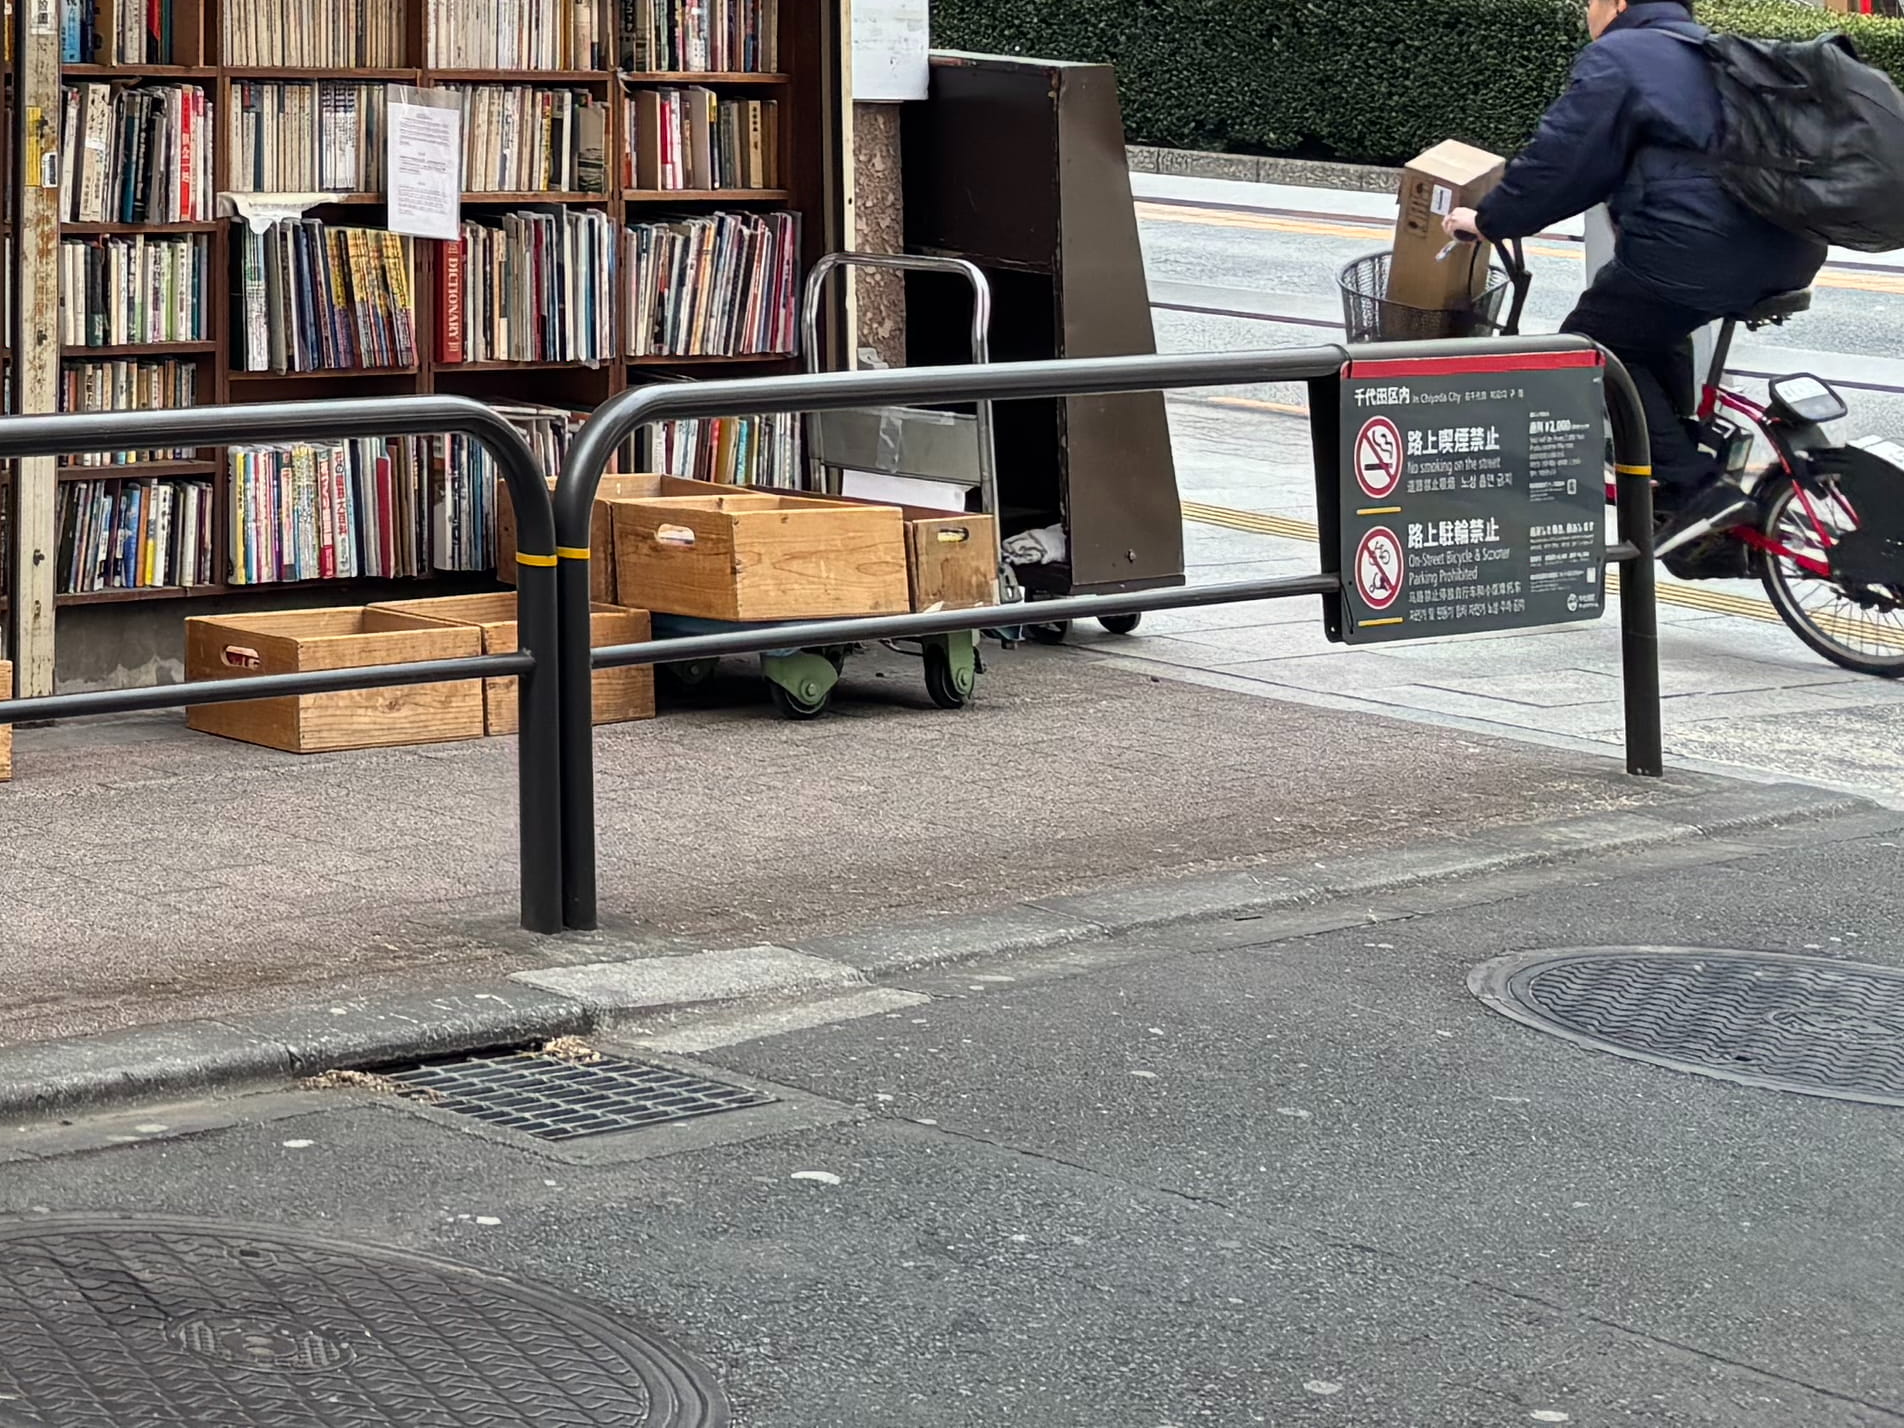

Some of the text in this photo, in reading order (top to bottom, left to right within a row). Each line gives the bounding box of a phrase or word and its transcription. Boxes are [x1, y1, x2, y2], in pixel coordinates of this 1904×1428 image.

[447, 256, 459, 338] DICTIONARY
[1354, 386, 1411, 408] 千代田区内
[1407, 425, 1501, 456] 路上喫煙禁止
[1419, 461, 1453, 475] smoking
[1453, 460, 1463, 472] on
[1463, 458, 1478, 471] the
[1479, 456, 1502, 470] street
[1407, 517, 1501, 549] 路上駐輪禁止
[1408, 550, 1445, 568] On-Street
[1446, 550, 1473, 567] Bicycle
[1408, 566, 1479, 587] Parking Prohibited
